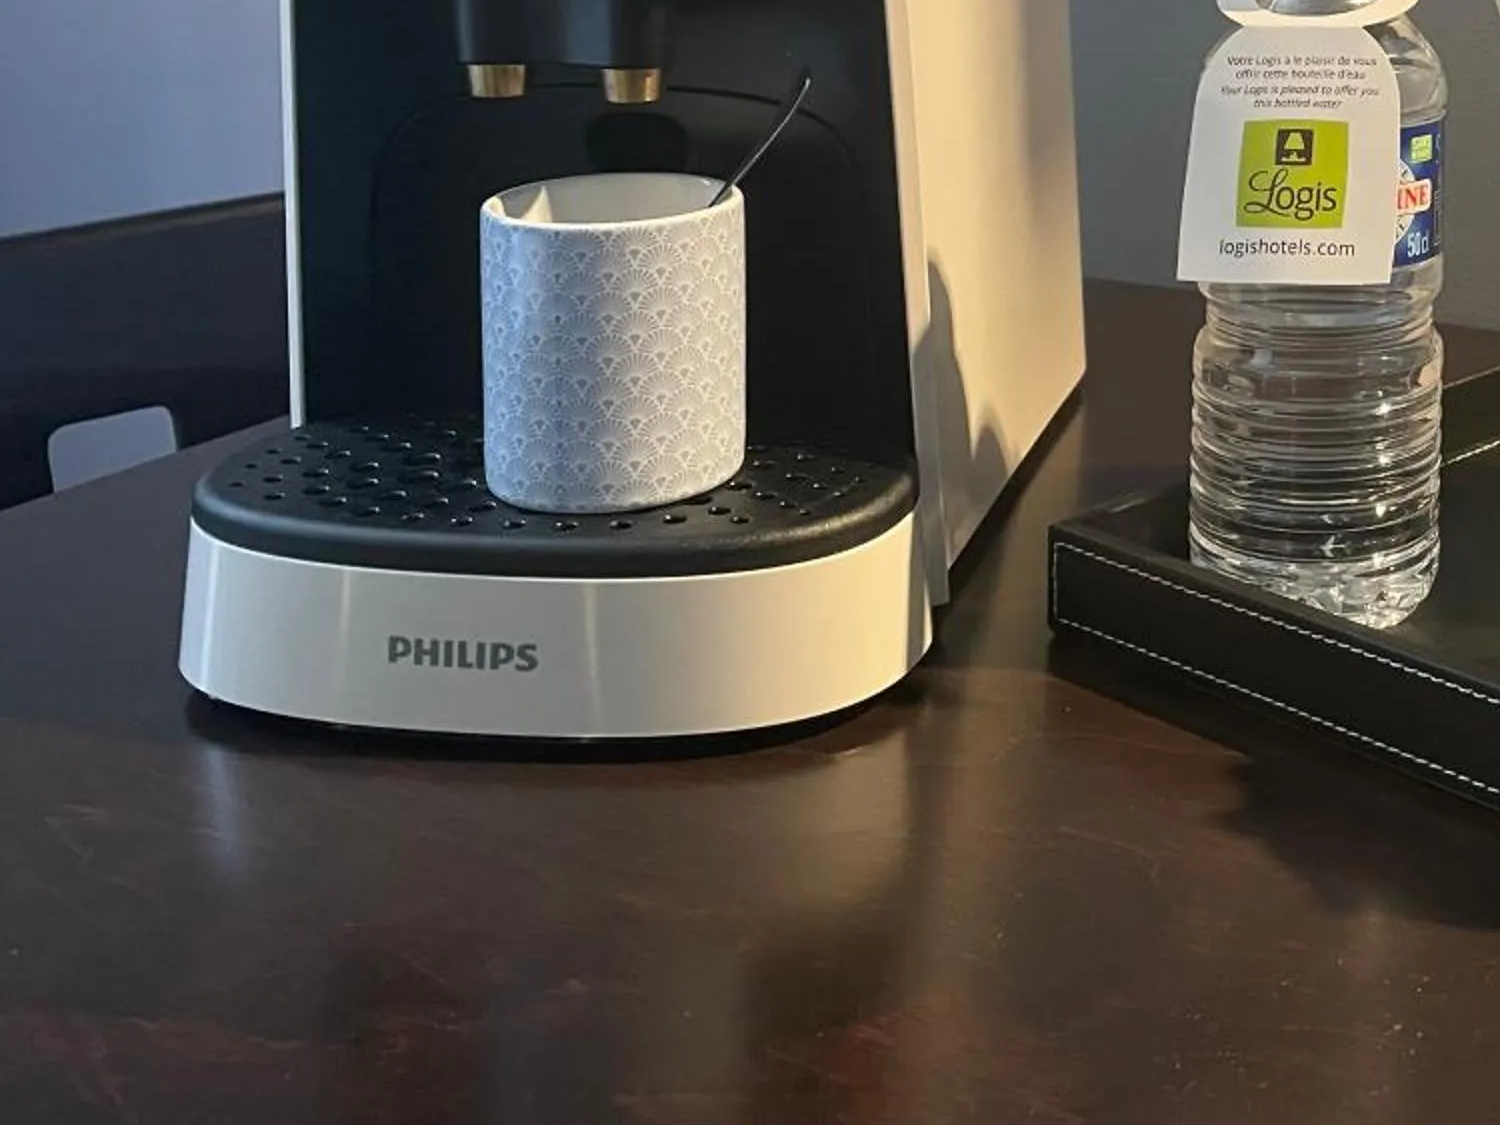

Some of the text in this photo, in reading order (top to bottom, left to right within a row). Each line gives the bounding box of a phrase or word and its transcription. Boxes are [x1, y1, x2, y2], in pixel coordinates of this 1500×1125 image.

[1243, 167, 1338, 221] Logis
[1397, 184, 1429, 210] INE
[1219, 237, 1356, 259] logishotels.com
[387, 635, 539, 672] PHILIPS
